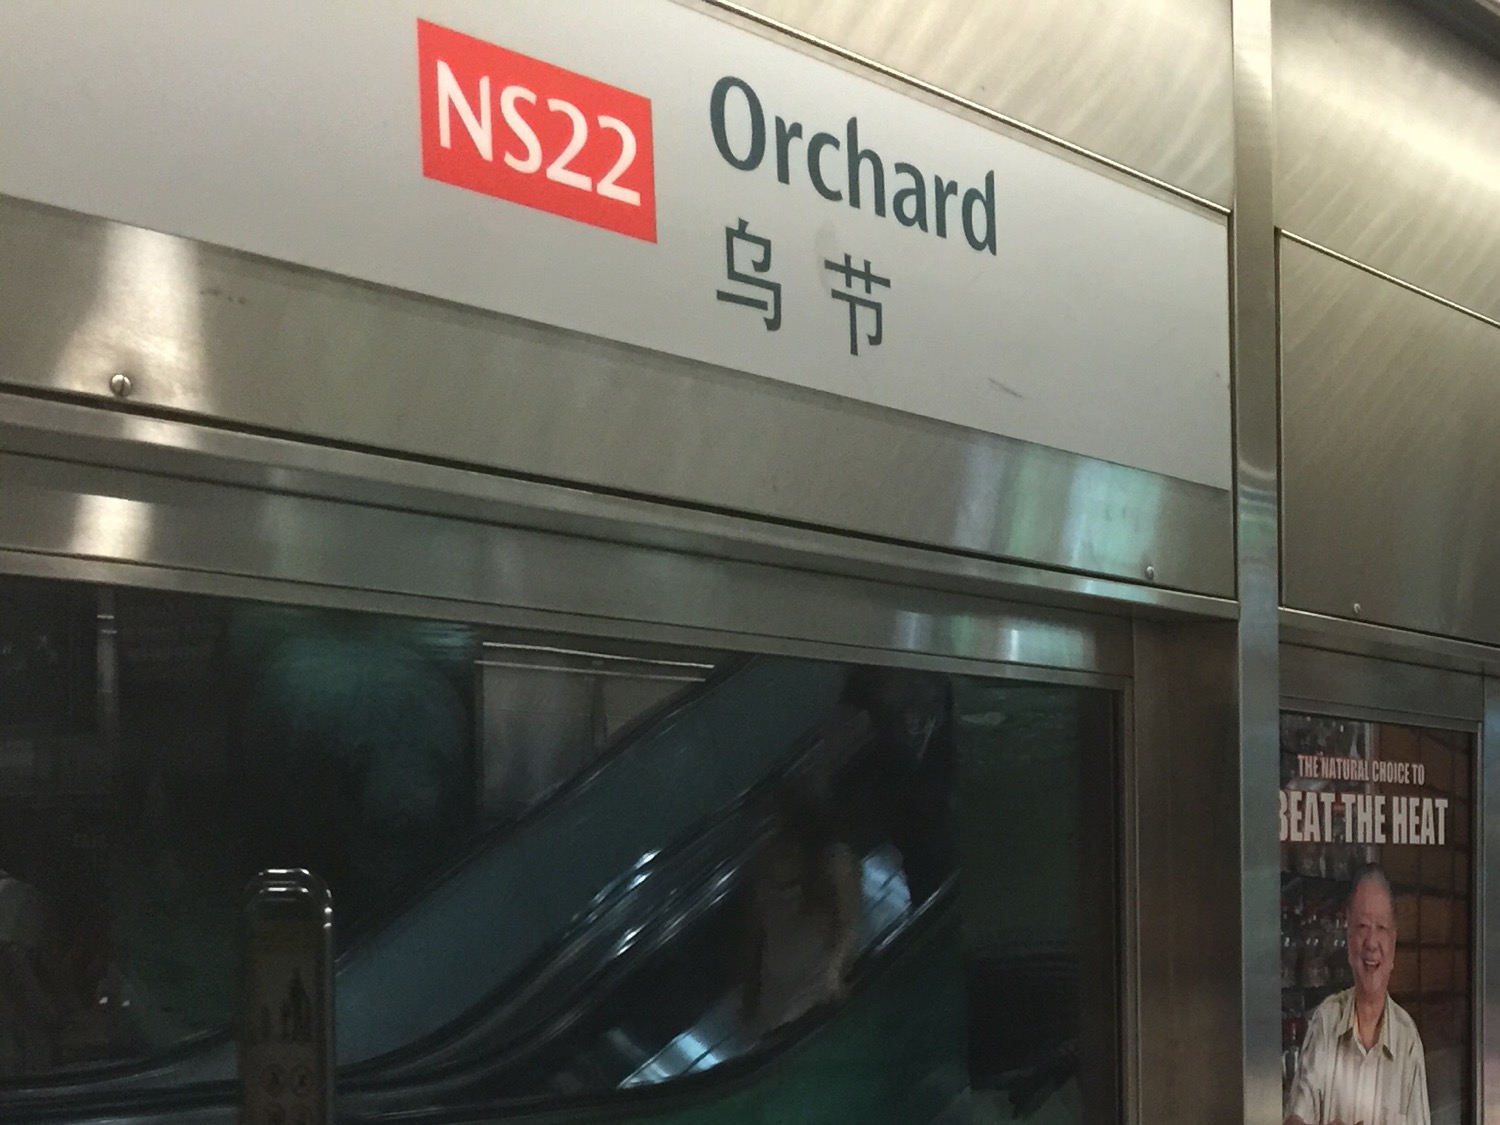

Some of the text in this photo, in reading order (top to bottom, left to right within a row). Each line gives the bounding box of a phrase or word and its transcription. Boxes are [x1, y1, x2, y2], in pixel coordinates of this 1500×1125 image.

[436, 59, 998, 256] NS22 Orchard
[715, 217, 892, 356] 乌节
[1280, 789, 1448, 845] BEAT THE HEAT
[1298, 754, 1425, 786] THE NATURAL CHOICE TO
